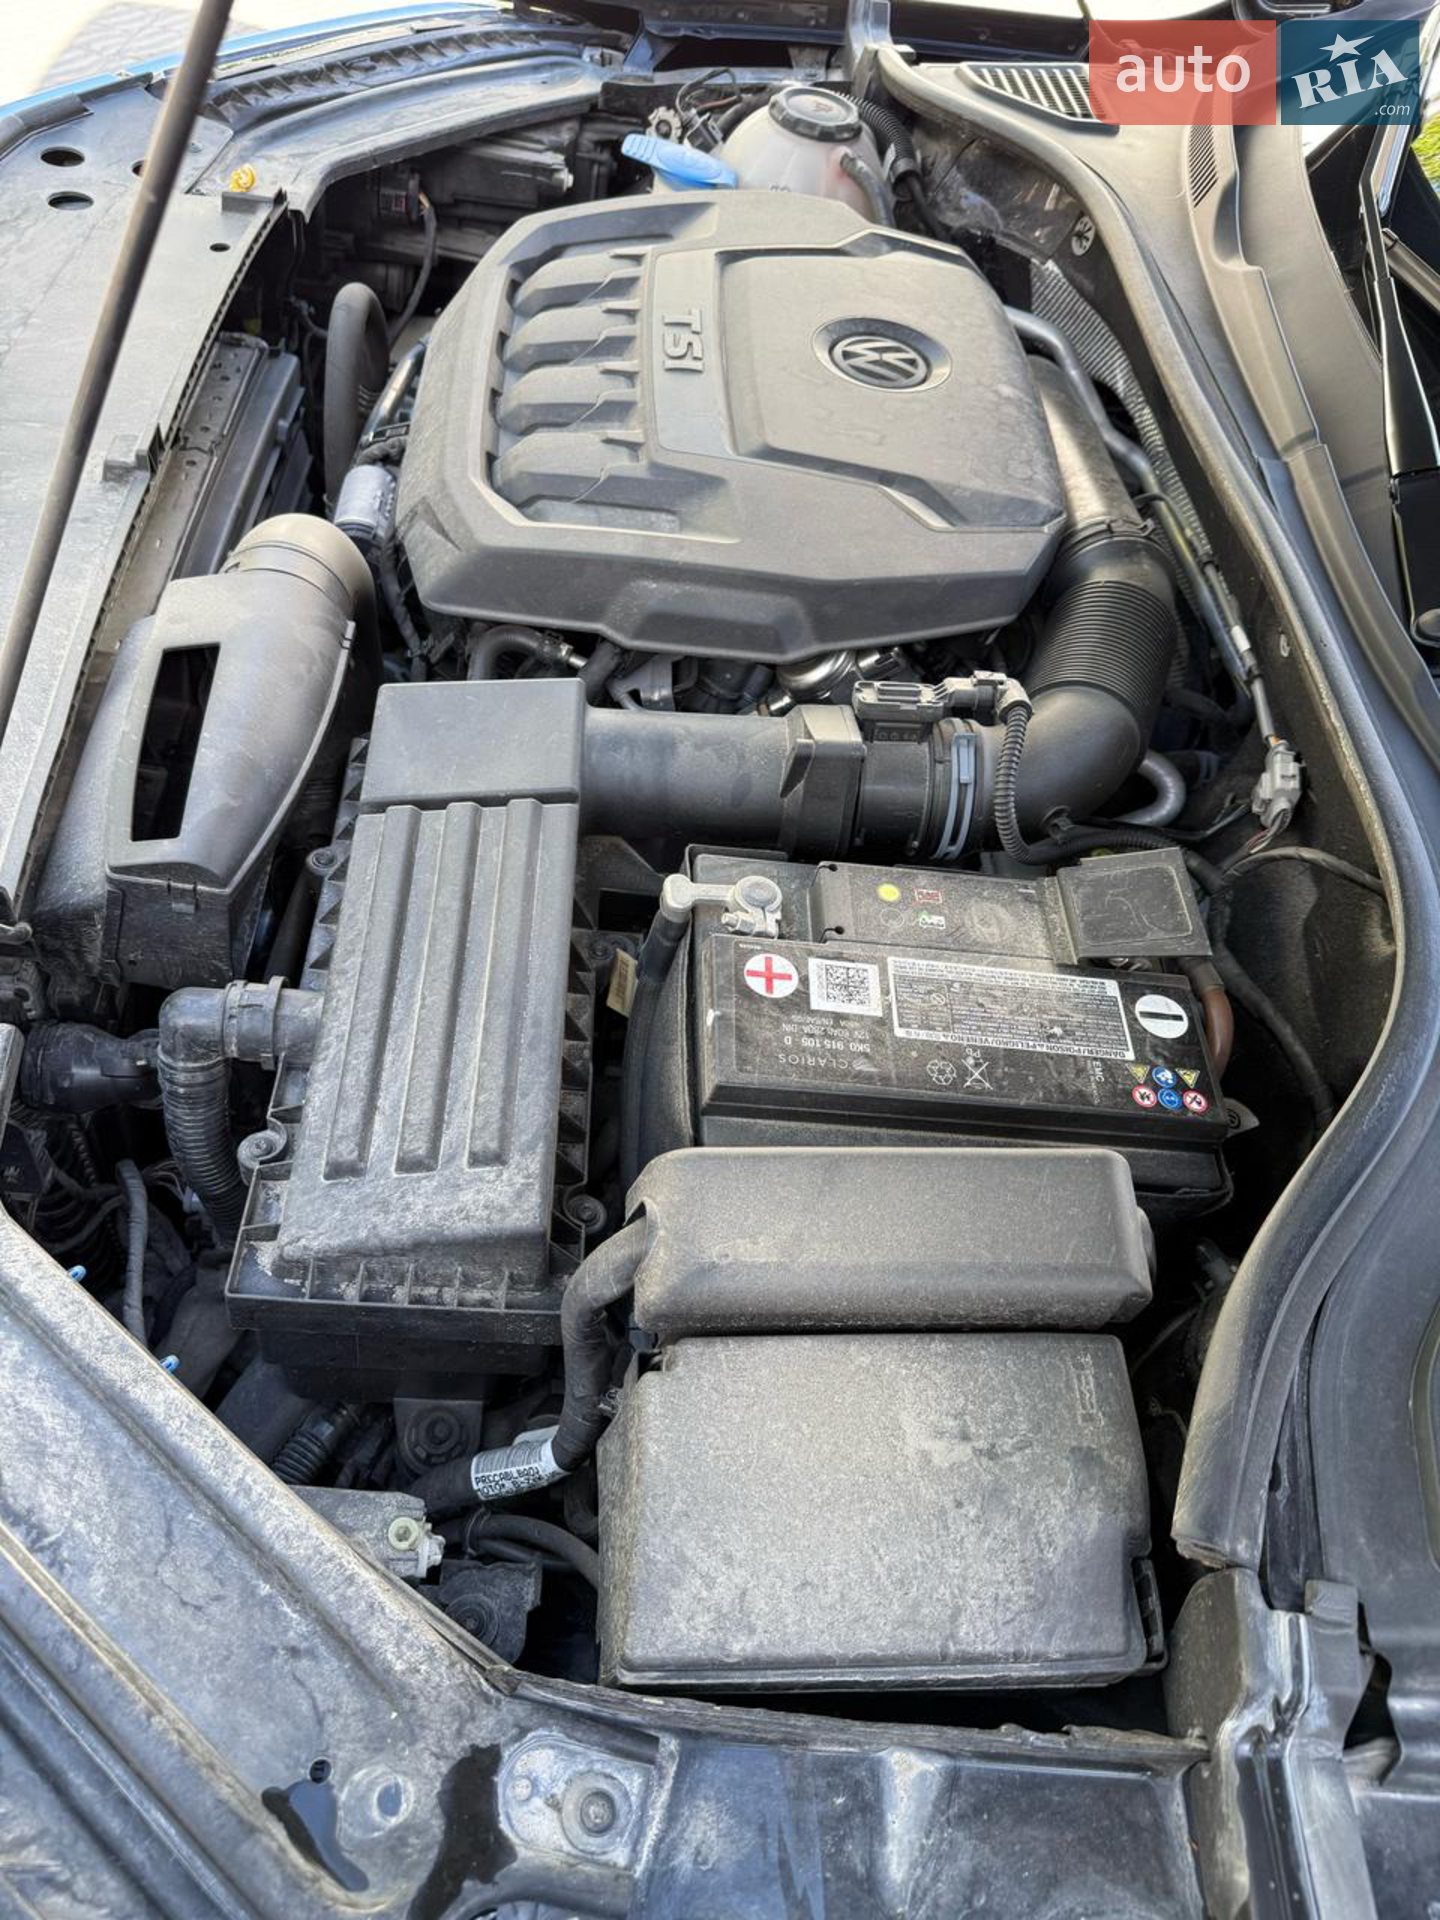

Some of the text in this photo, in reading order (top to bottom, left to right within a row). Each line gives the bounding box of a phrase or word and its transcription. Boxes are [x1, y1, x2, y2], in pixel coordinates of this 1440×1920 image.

[662, 308, 705, 374] TSI
[782, 1023, 797, 1033] DIN
[784, 1035, 870, 1052] 5K0 915 105 D
[966, 1047, 980, 1058] Pb
[778, 1053, 849, 1069] CLARIOS
